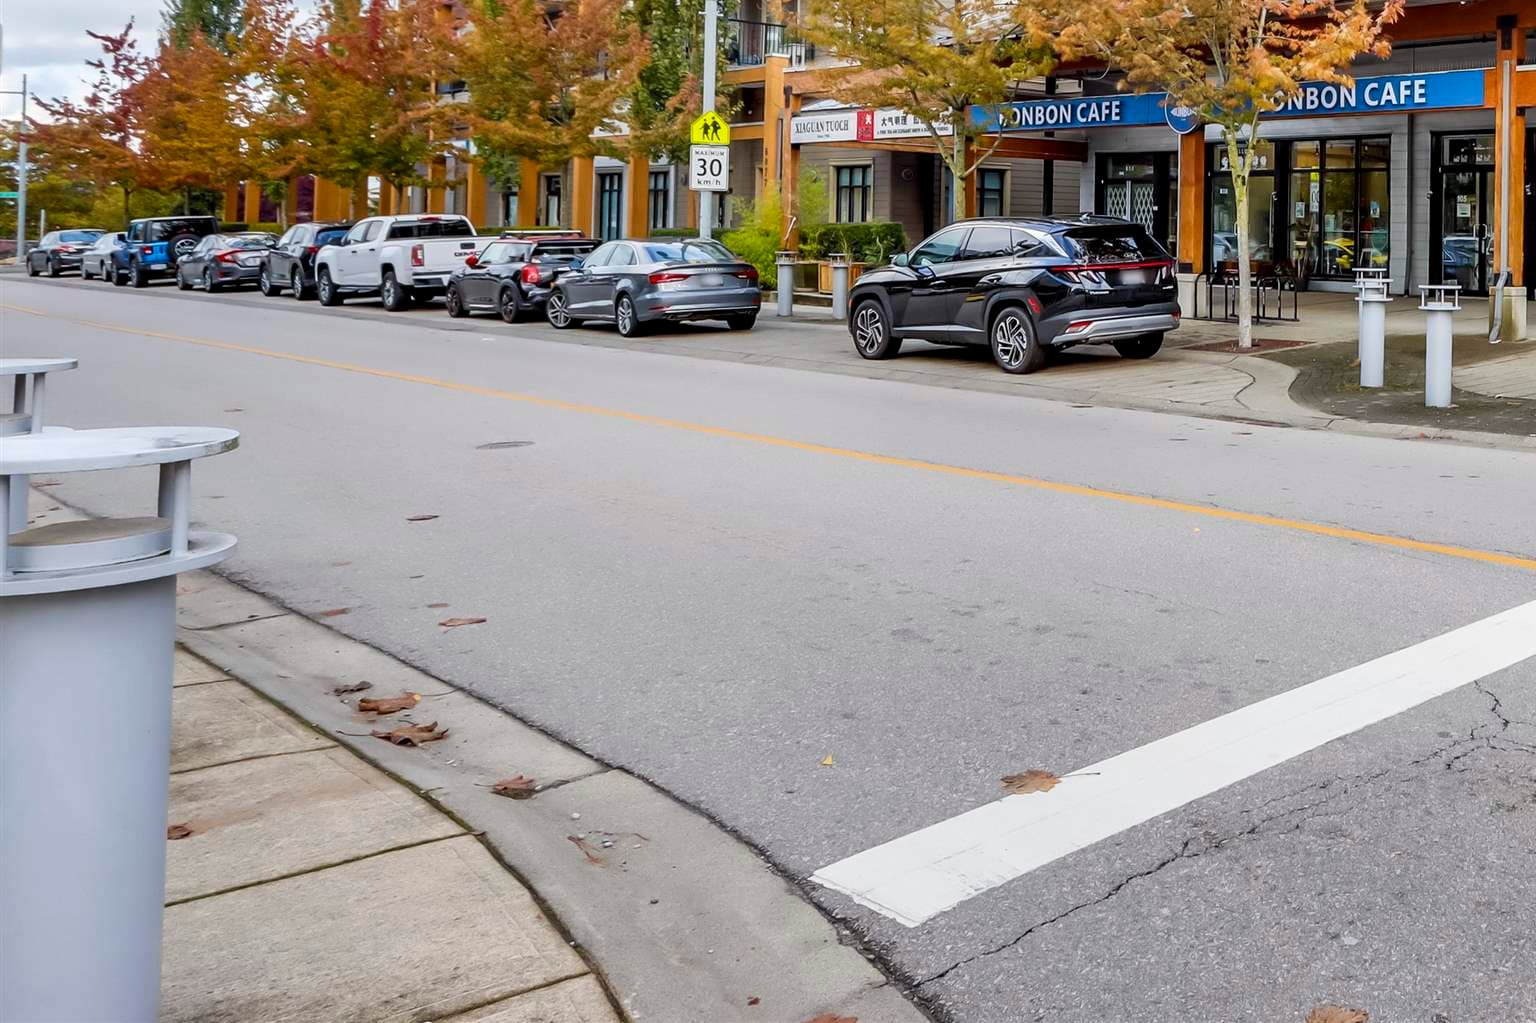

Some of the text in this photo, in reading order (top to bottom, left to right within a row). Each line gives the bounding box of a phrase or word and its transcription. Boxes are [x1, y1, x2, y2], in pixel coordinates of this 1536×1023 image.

[1257, 79, 1426, 113] ONBON CAFE
[1076, 100, 1121, 123] CAFE
[696, 158, 722, 177] 30
